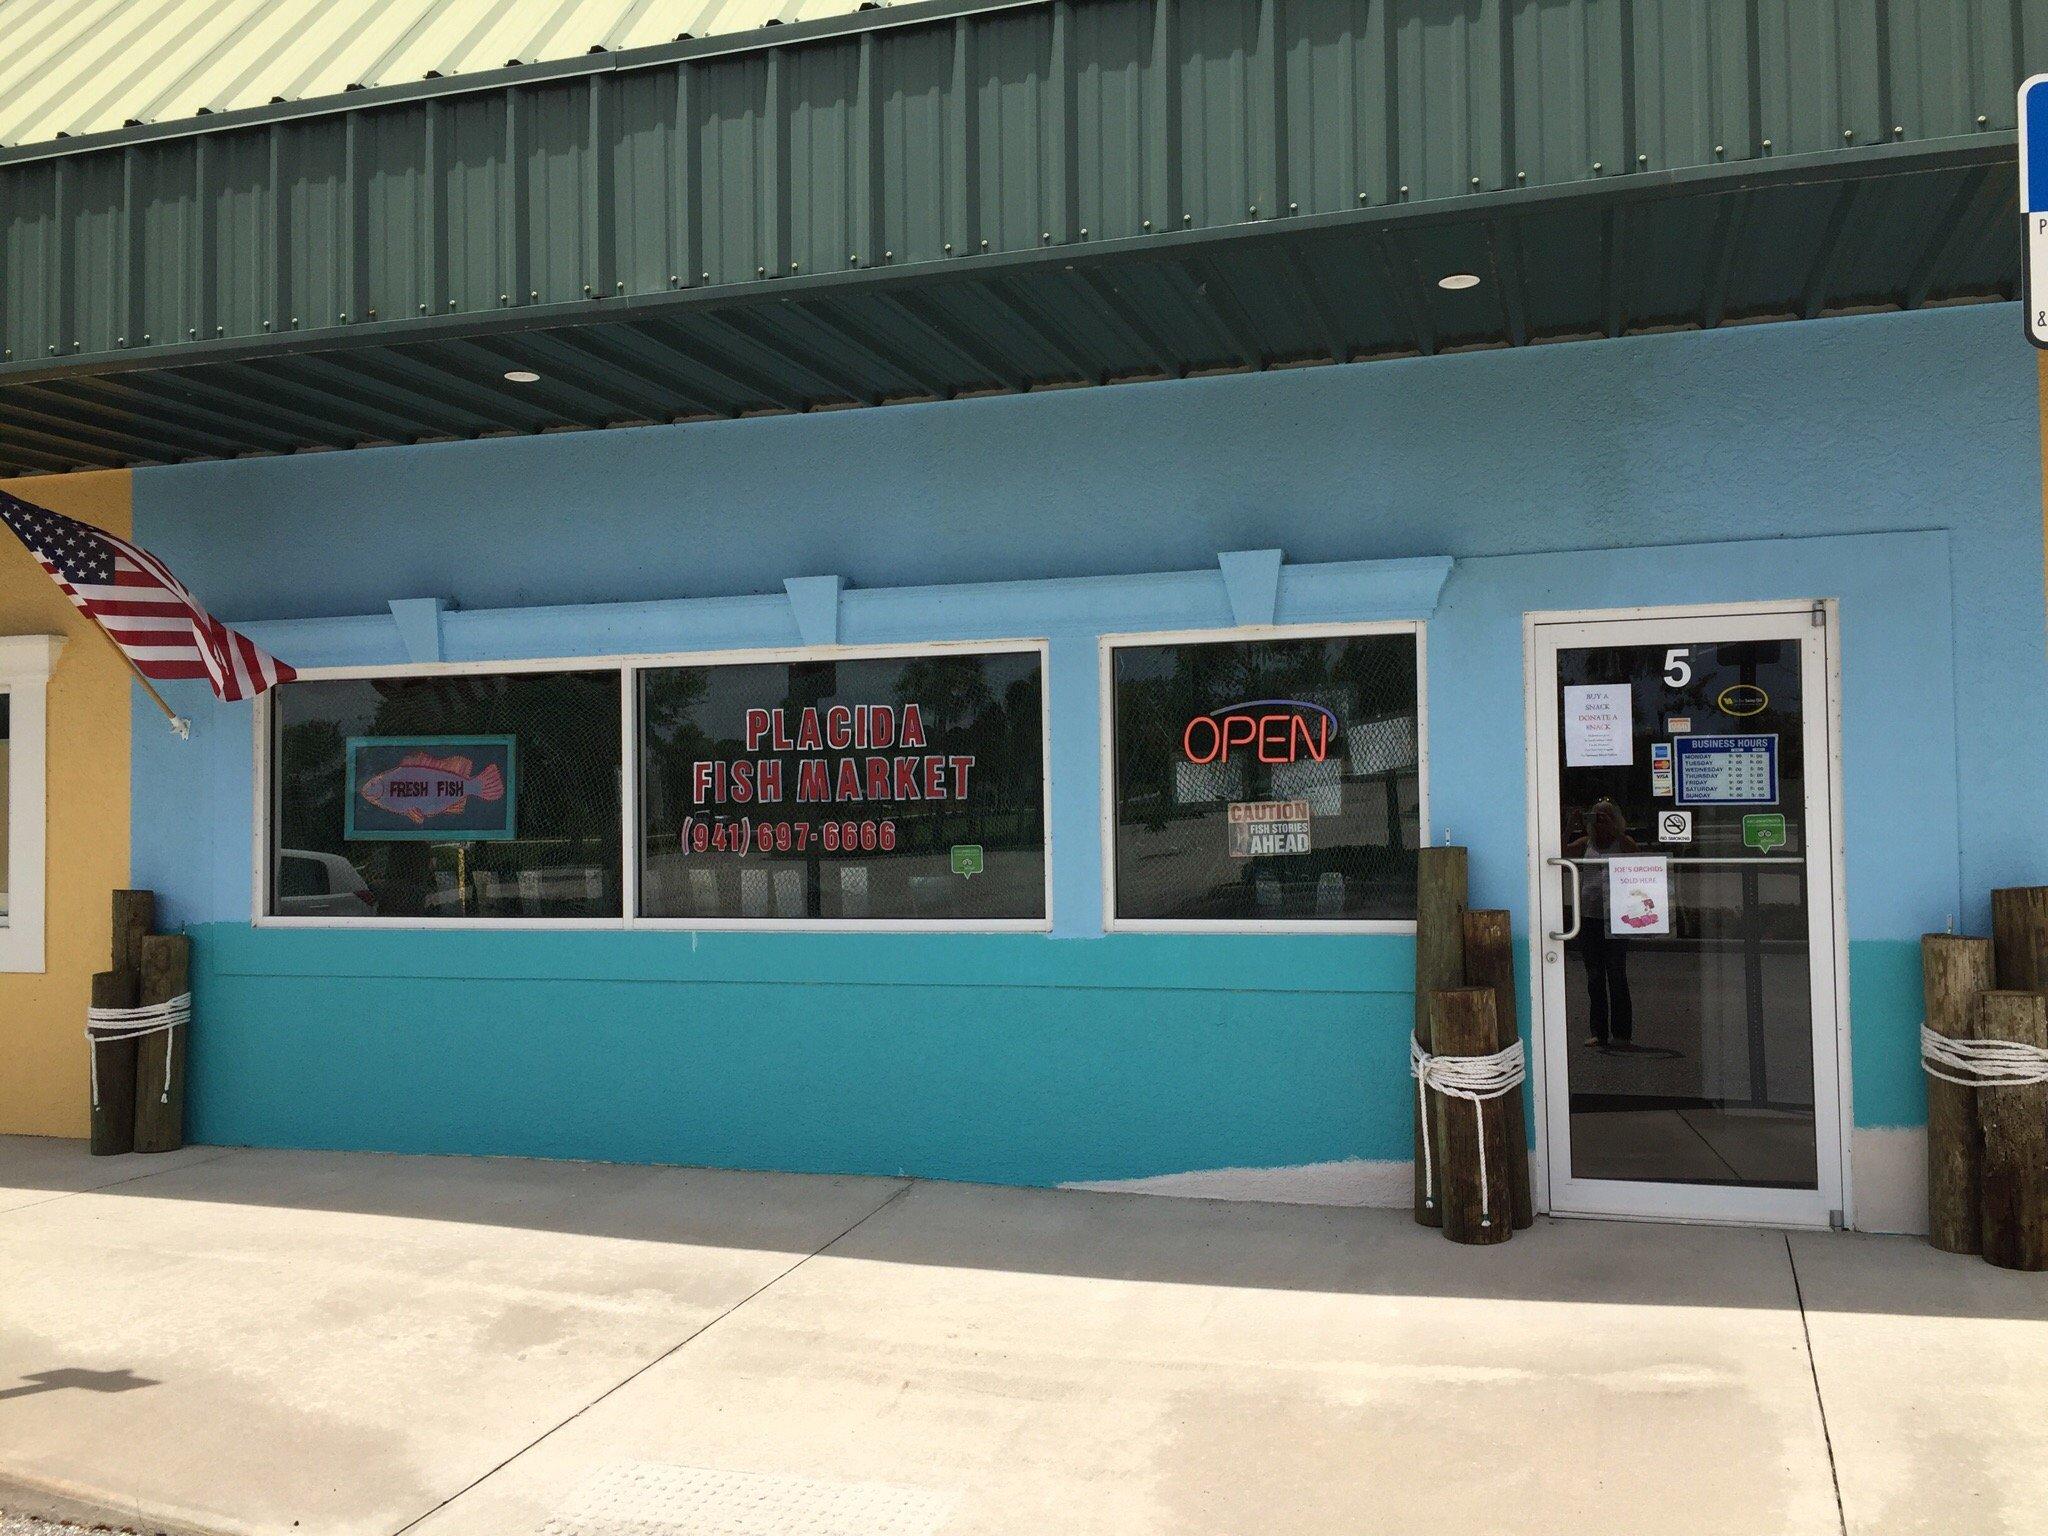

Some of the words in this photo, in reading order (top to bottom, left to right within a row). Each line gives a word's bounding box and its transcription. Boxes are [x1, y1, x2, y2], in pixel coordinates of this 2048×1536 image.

[1663, 649, 1692, 688] 5
[746, 703, 927, 751] PLACIDA
[1184, 714, 1327, 764] OPEN
[1691, 740, 1735, 748] BUSINESS
[1737, 739, 1768, 748] HOURS
[389, 781, 428, 797] FRESH
[437, 780, 464, 797] FISH
[693, 759, 783, 804] FISH
[796, 756, 976, 803] MARKET
[1230, 803, 1308, 821] CAUTION
[681, 816, 750, 858] (941)
[757, 820, 897, 852] 697-6666
[1250, 824, 1270, 834] FISH
[1272, 823, 1309, 833] STORIES
[1250, 834, 1309, 854] AHEAD
